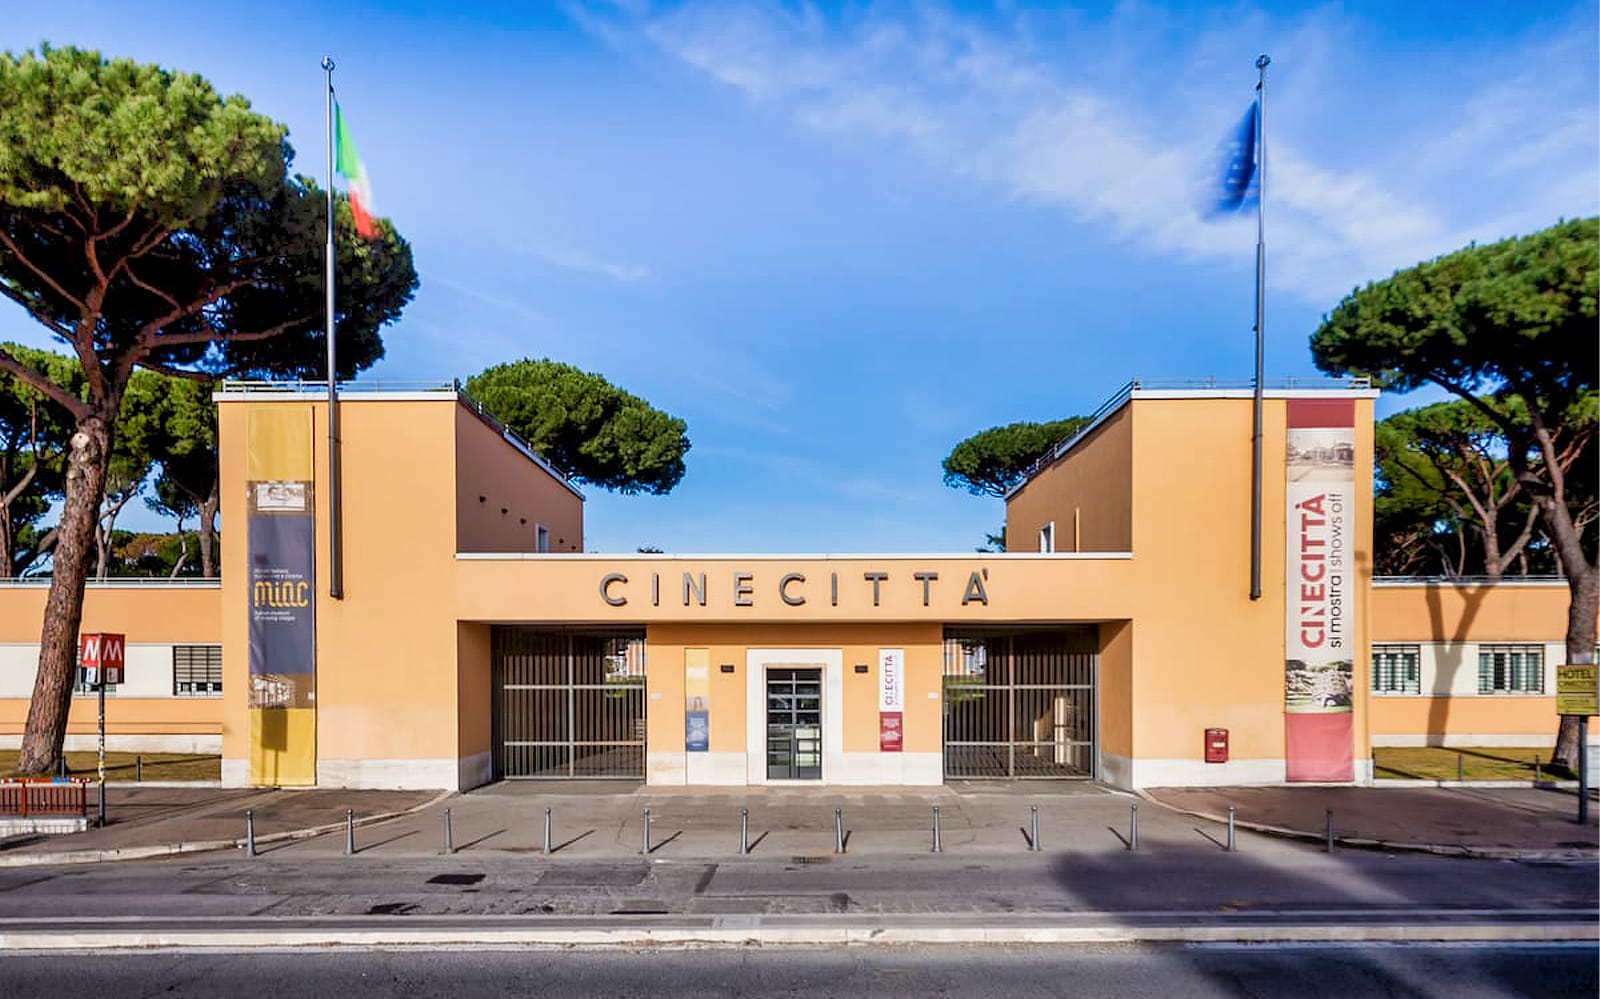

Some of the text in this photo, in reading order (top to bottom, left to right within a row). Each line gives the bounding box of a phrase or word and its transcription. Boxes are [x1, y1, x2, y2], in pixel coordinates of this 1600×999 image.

[1295, 494, 1325, 648] CINECITTÀ
[1328, 493, 1343, 648] si mostra shows off
[103, 639, 122, 661] M
[1558, 669, 1594, 679] HOTEL
